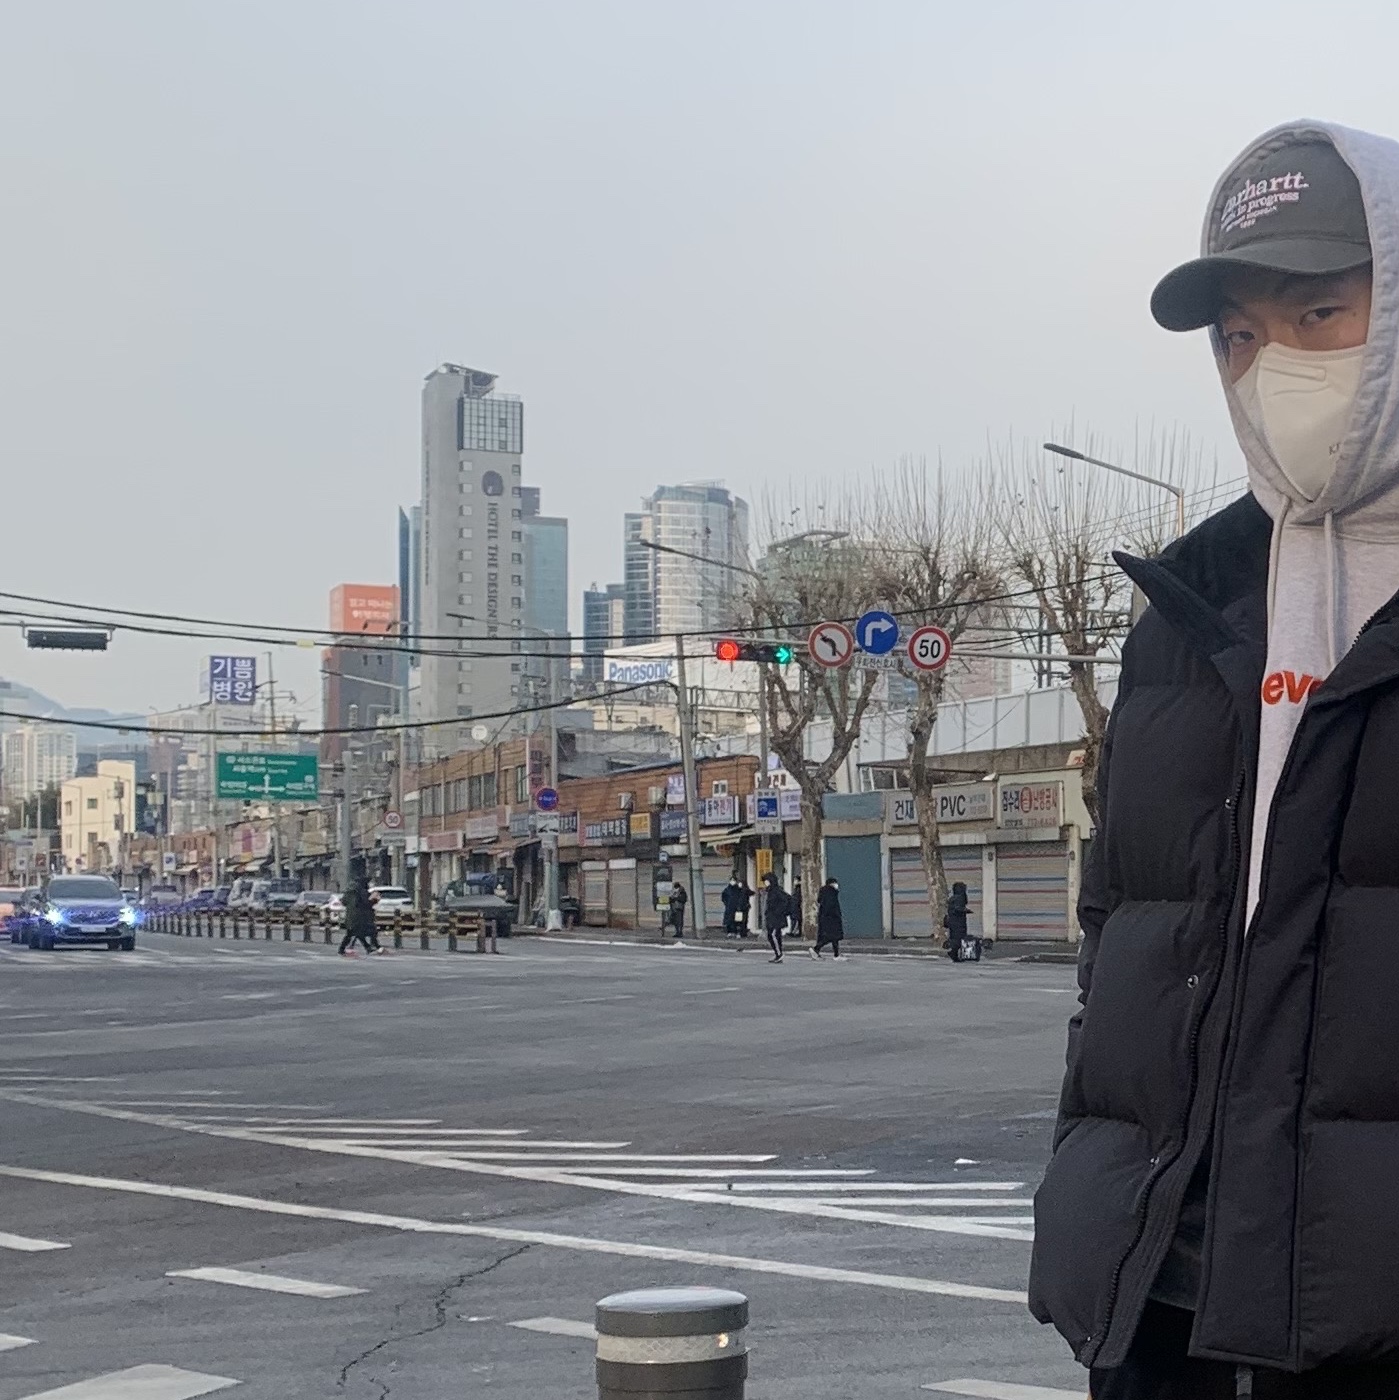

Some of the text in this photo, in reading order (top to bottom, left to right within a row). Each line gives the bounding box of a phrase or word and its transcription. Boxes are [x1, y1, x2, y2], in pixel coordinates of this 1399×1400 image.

[487, 501, 498, 541] HOTEL
[487, 544, 498, 571] THE
[918, 639, 941, 659] 50
[213, 657, 253, 679] 기쁨
[608, 660, 673, 683] Panasonic
[213, 680, 253, 702] 병원
[940, 794, 967, 818] PVC
